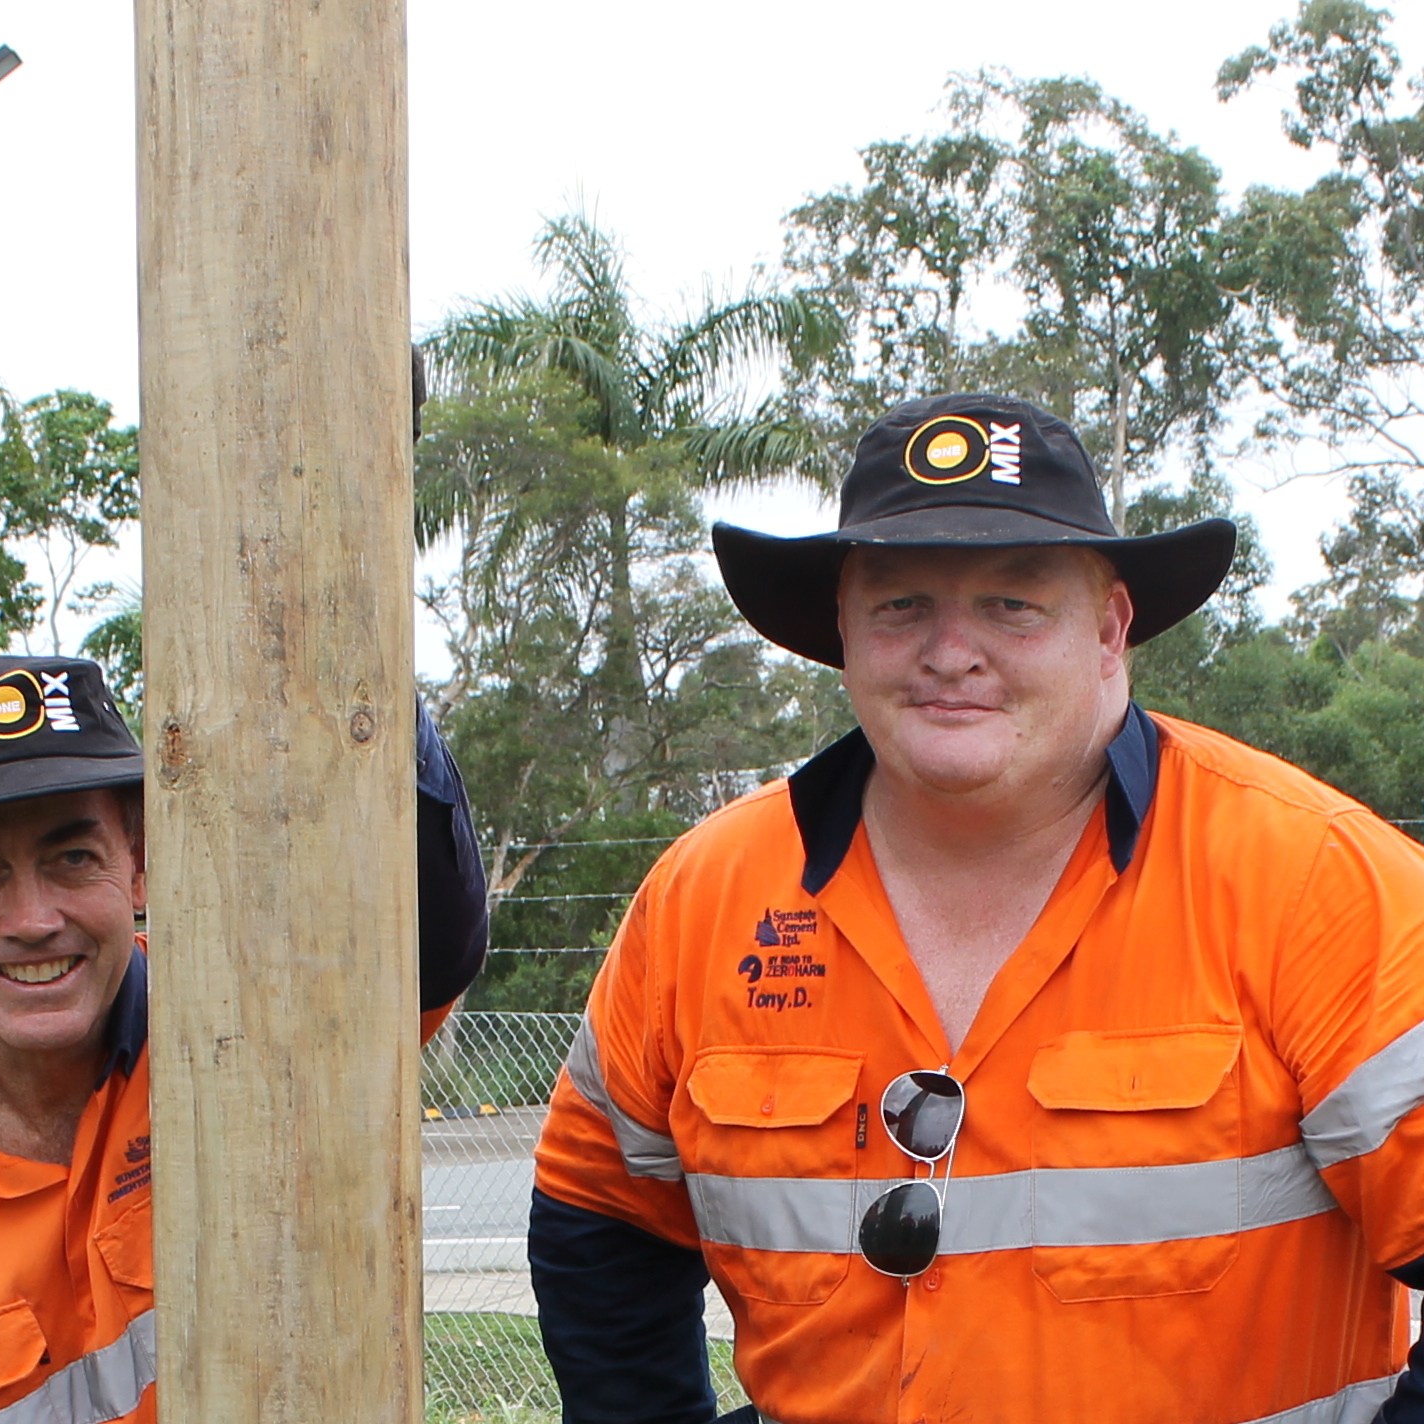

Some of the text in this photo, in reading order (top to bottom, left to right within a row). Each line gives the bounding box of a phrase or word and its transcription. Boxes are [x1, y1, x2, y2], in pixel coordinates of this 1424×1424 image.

[931, 446, 962, 459] ONE
[990, 422, 1021, 486] MIX
[41, 671, 80, 731] MIX
[773, 909, 816, 922] Sunstate
[777, 922, 817, 934] Cement
[857, 1113, 866, 1142] DNC
